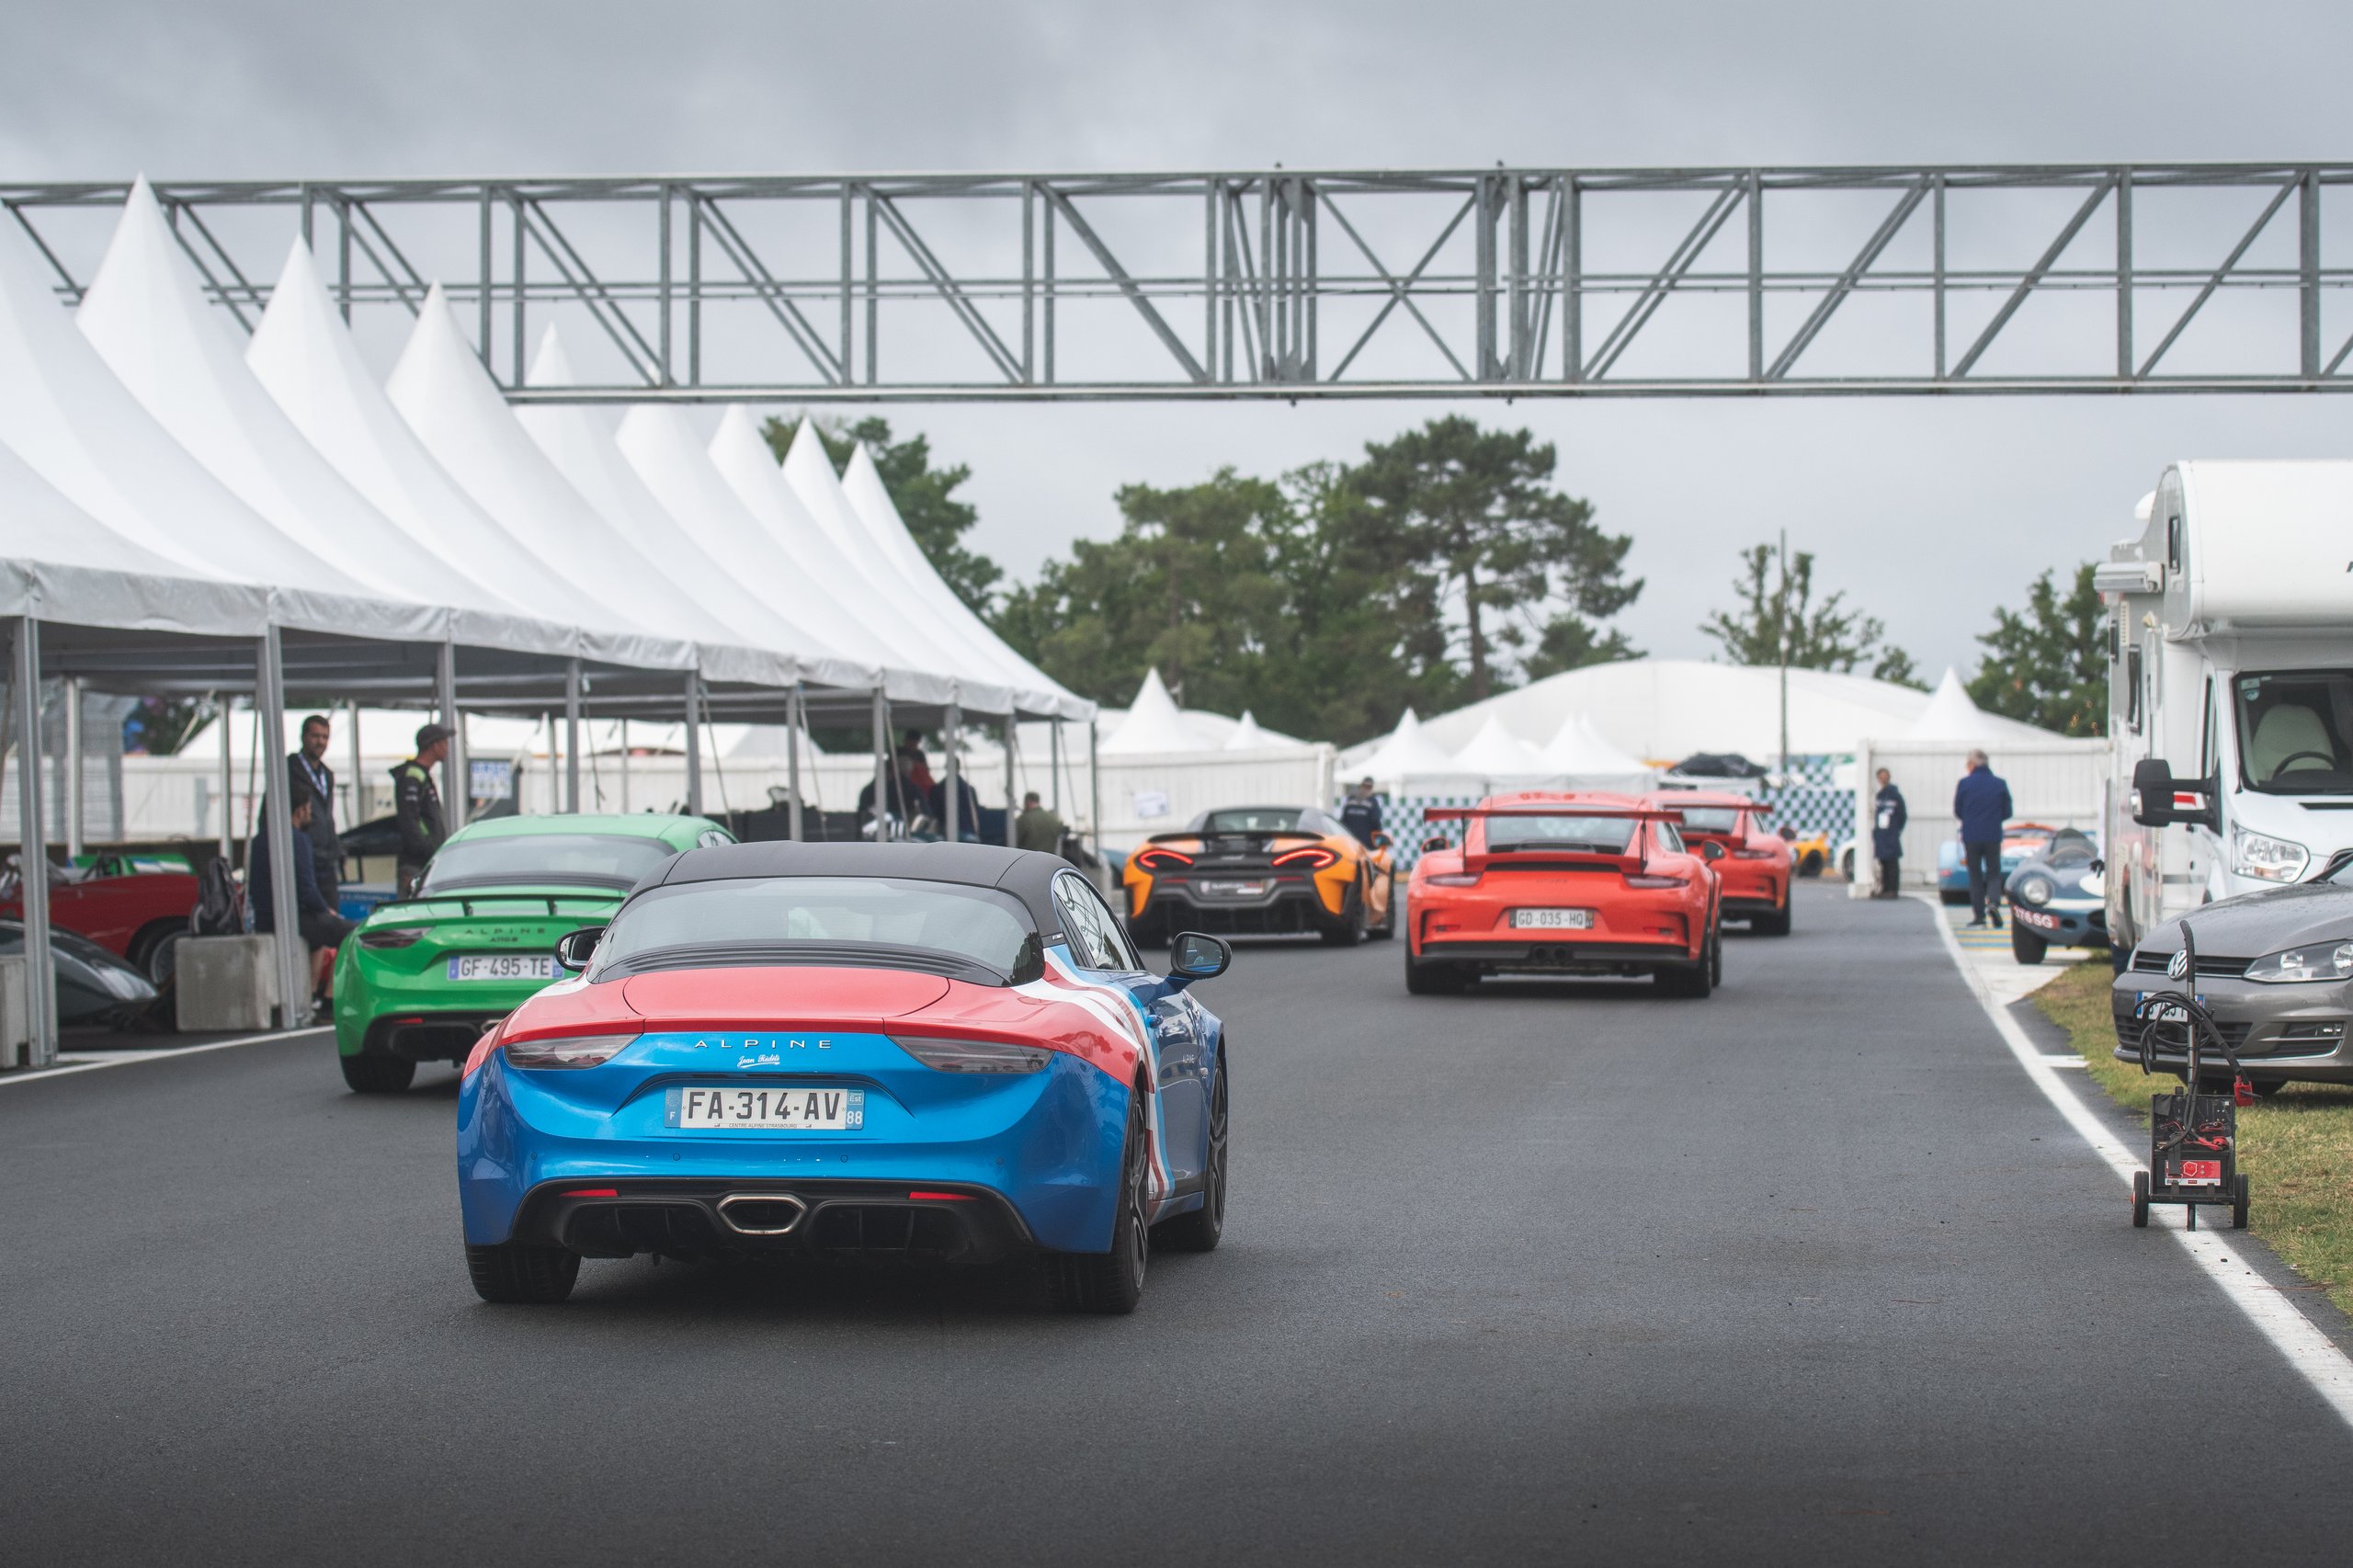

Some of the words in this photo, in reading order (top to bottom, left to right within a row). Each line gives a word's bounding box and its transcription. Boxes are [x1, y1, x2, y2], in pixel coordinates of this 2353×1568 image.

[460, 958, 550, 976] GF-495-TE
[694, 1040, 832, 1050] ALPINE
[737, 1055, 755, 1068] Jean
[688, 1091, 840, 1120] FA-314-AV
[847, 1110, 863, 1124] 88
